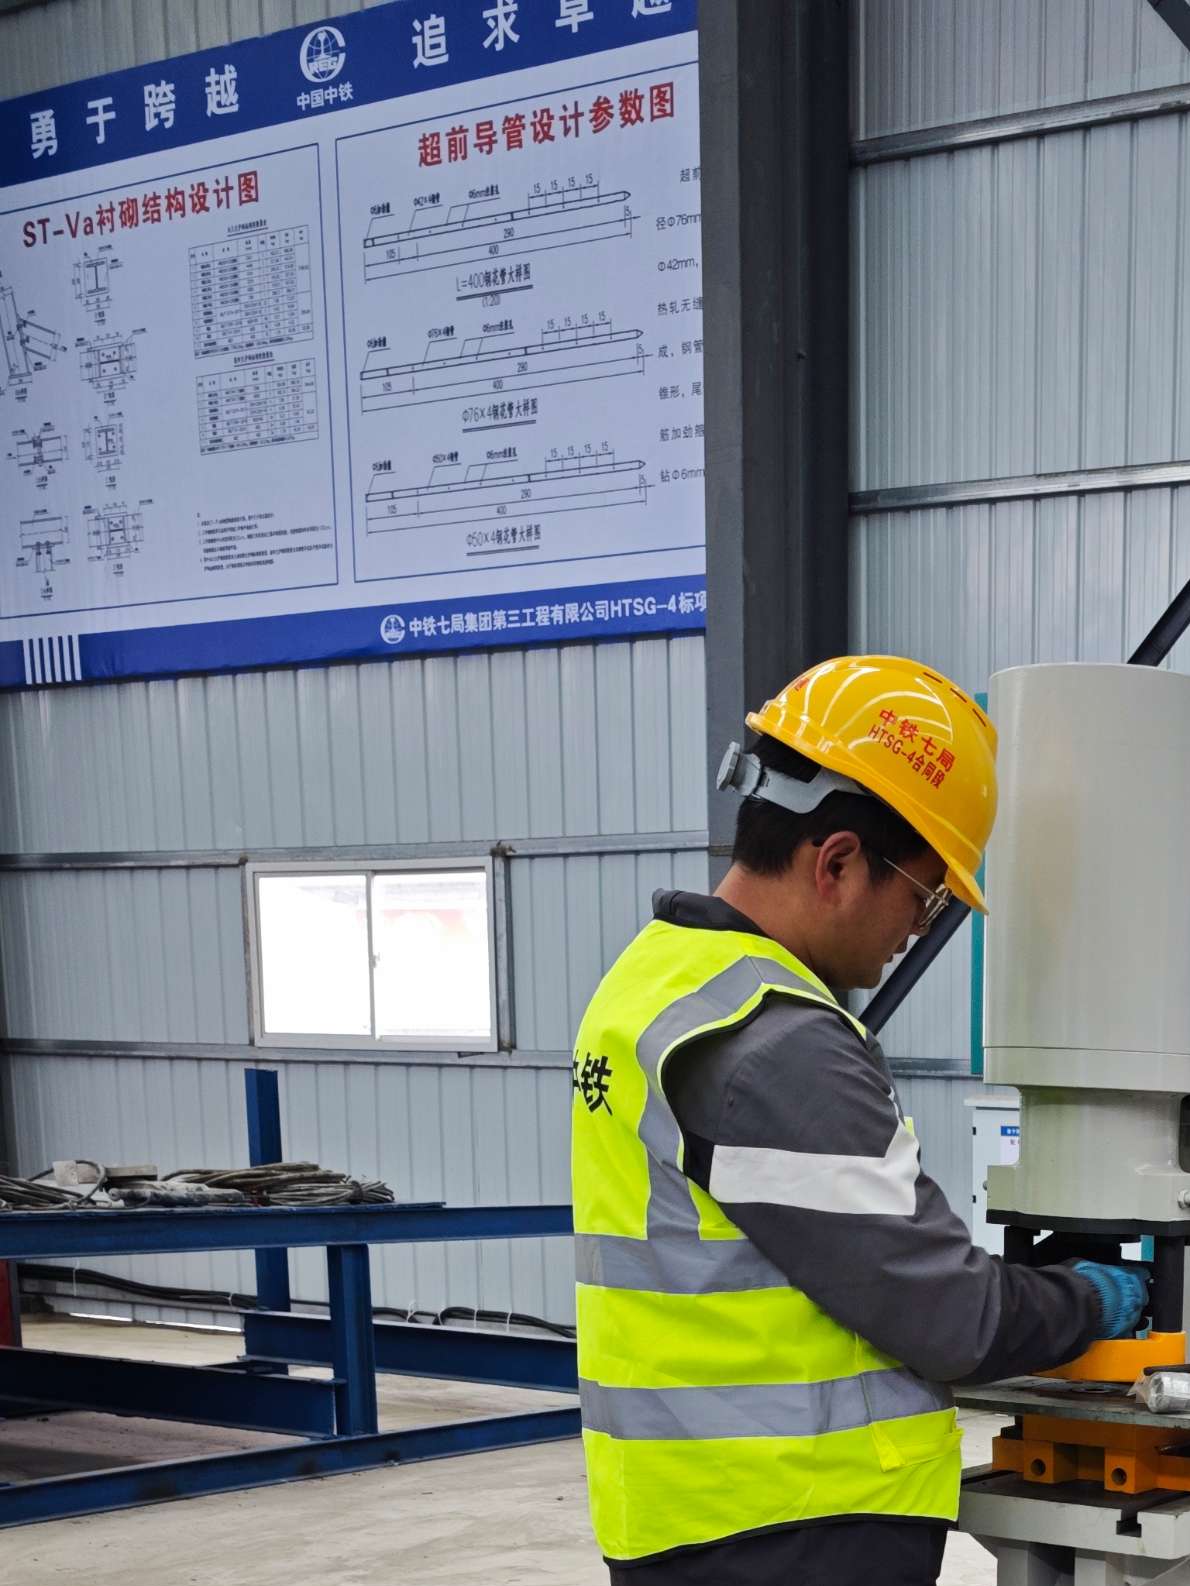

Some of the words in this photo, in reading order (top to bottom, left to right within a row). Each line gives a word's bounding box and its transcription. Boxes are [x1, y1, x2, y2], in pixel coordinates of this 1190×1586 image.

[296, 81, 354, 112] 中国中铁
[417, 82, 675, 168] 超前导管设计参数图
[22, 170, 260, 249] ST-Va衬砌结构设计图
[867, 725, 946, 789] HTSG-4合同段
[879, 708, 956, 772] 中铁七局
